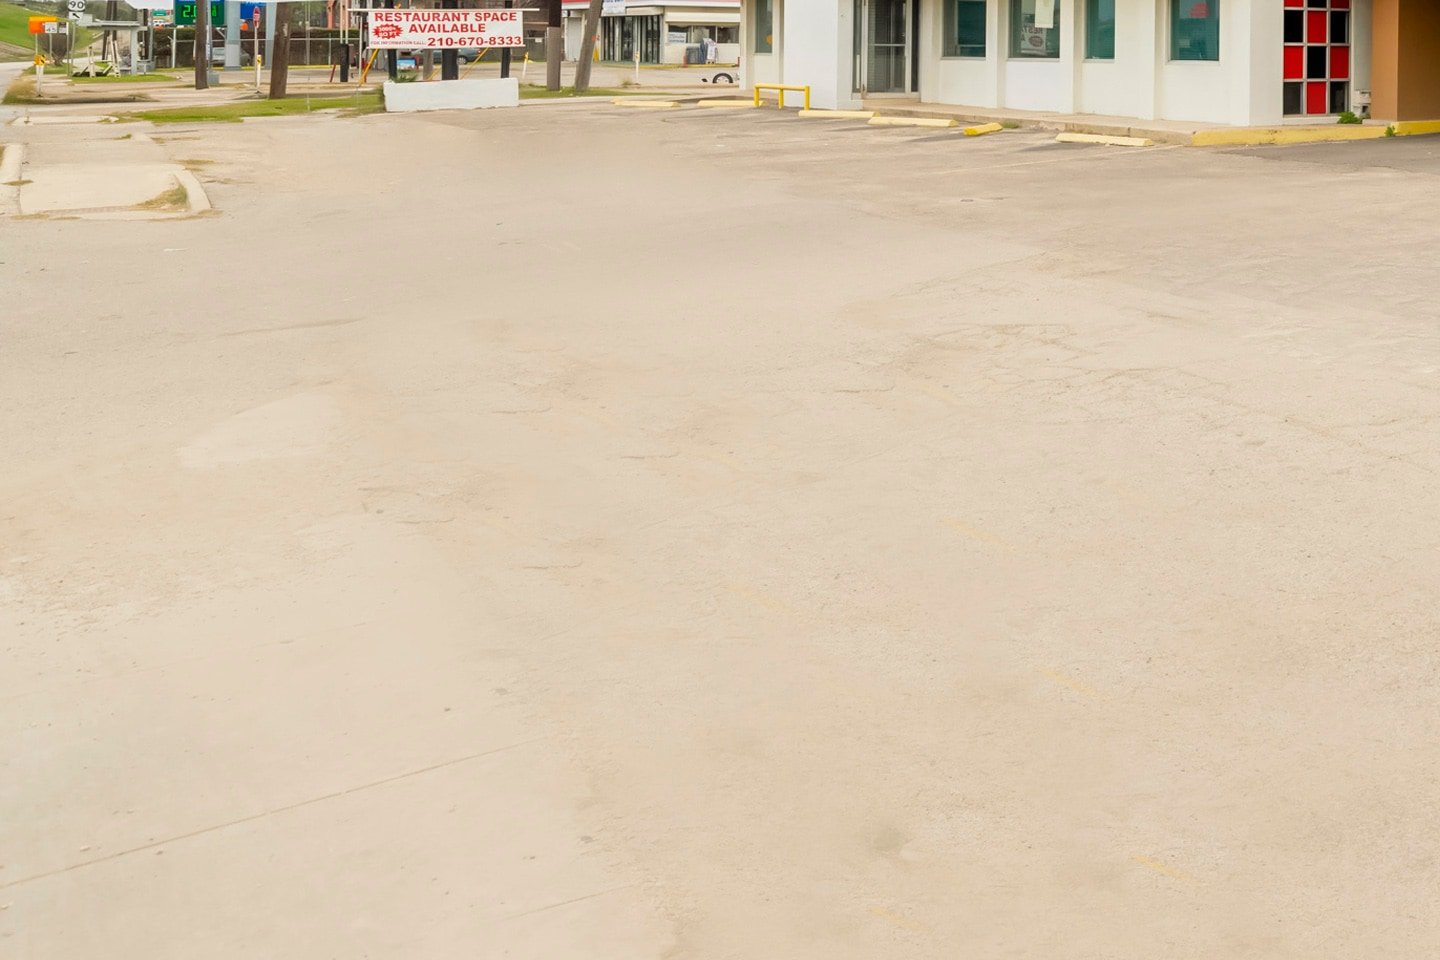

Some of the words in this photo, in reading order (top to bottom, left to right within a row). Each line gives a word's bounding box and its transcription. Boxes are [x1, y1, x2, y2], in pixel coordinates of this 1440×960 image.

[69, 0, 84, 9] 90
[374, 12, 470, 22] RESTAURANT
[474, 11, 517, 22] SPACE
[409, 23, 486, 33] AVAILABLE
[427, 36, 522, 47] 210-670-8333
